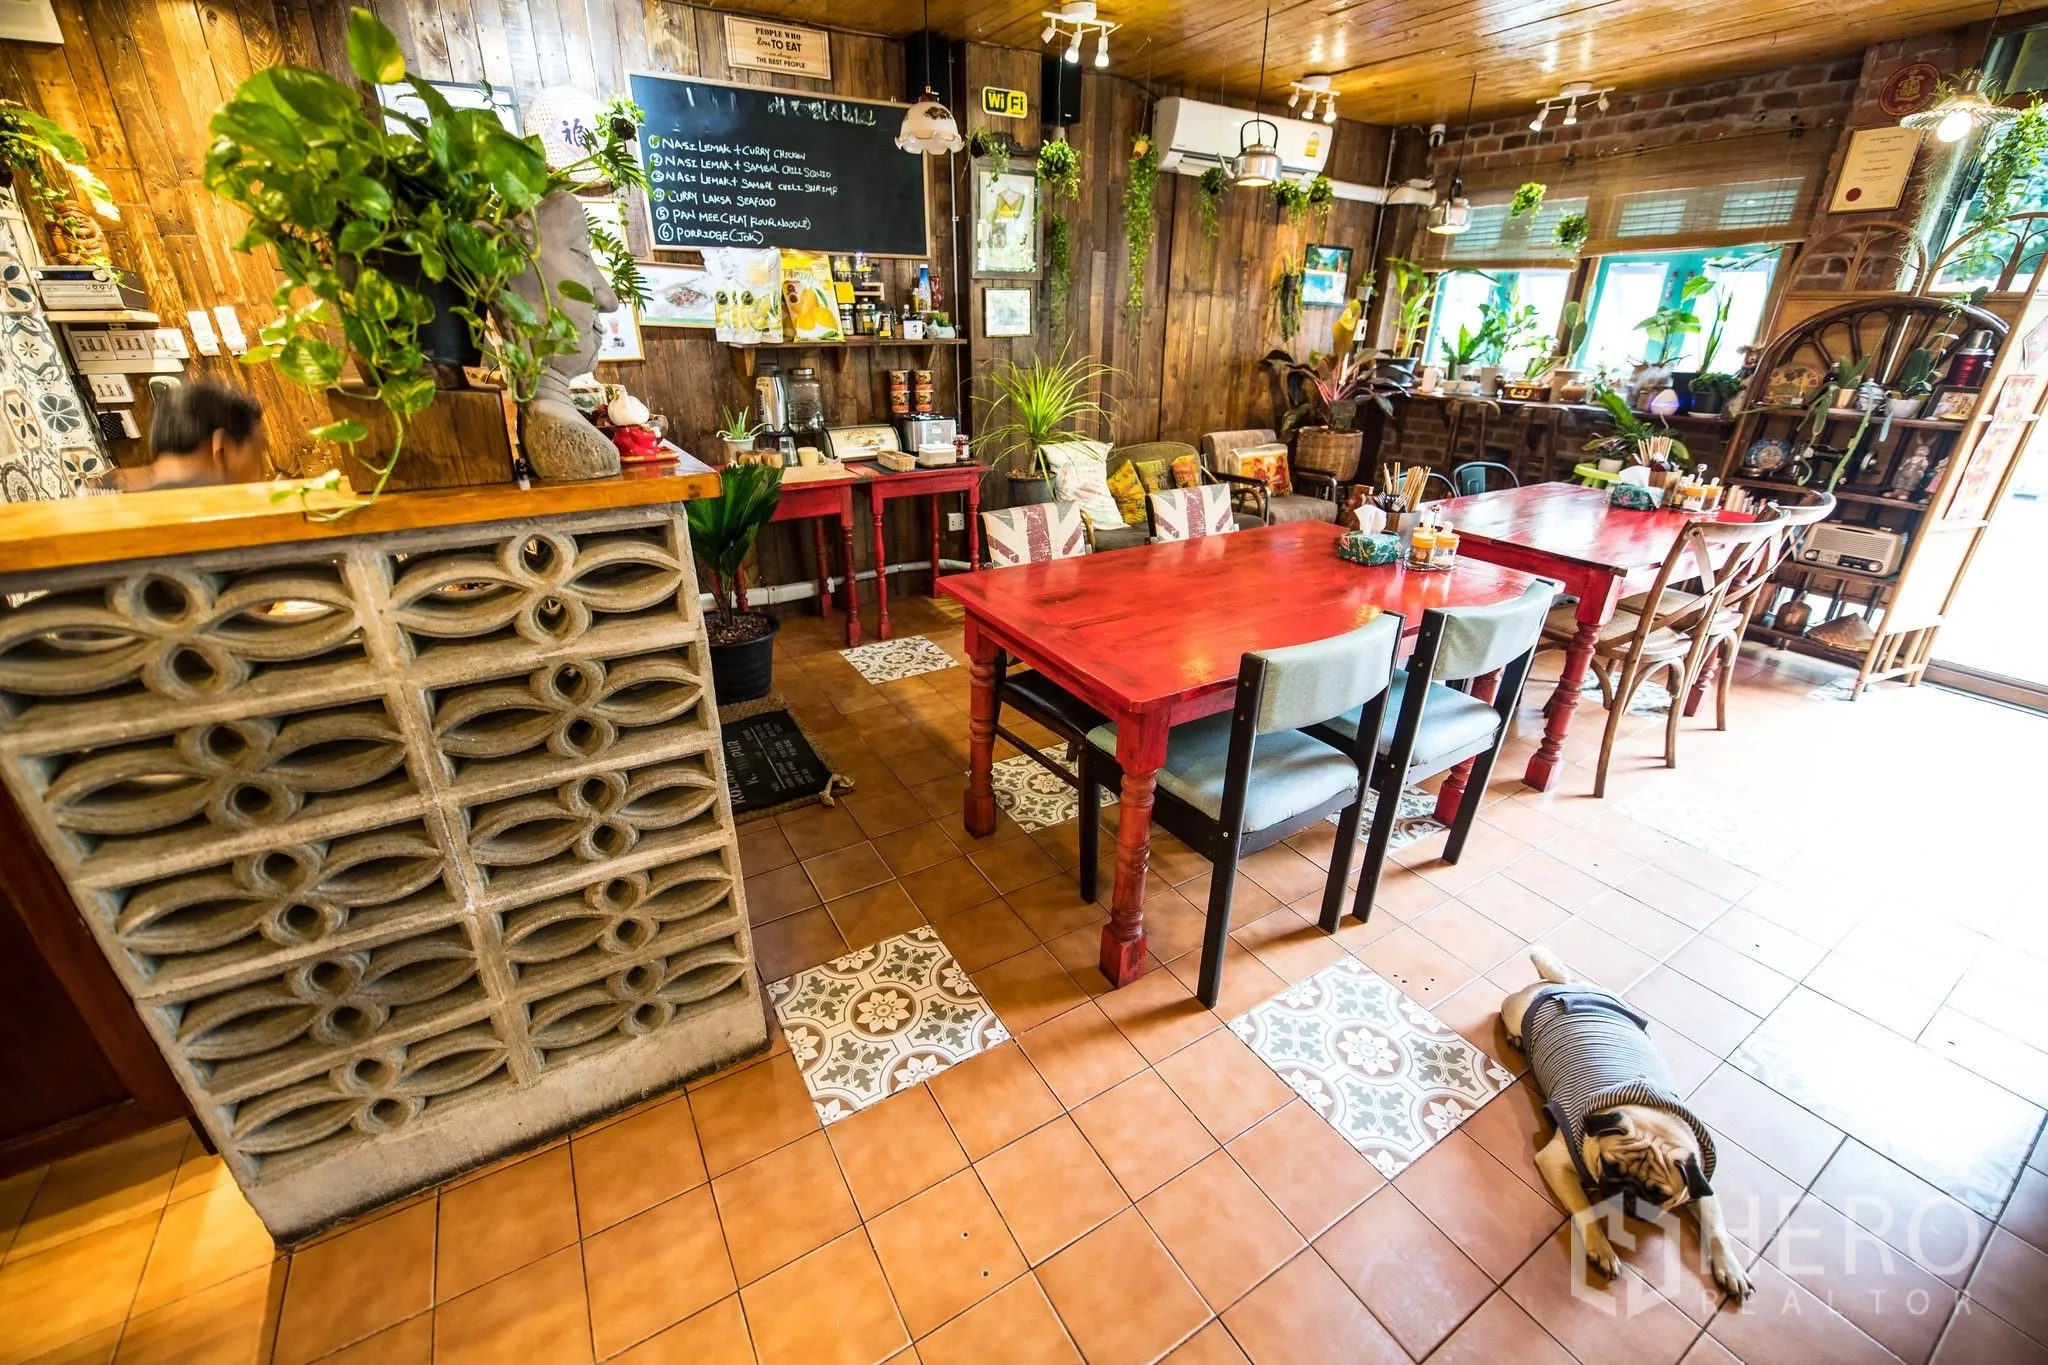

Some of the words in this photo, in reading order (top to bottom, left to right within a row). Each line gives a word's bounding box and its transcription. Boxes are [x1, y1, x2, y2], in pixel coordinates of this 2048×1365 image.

[755, 27, 782, 38] PEOPLE
[784, 32, 801, 40] WHO
[771, 39, 783, 50] TO
[785, 41, 801, 52] EAT
[756, 56, 767, 64] THE
[768, 58, 782, 66] BEST
[784, 60, 805, 69] PEOPLE
[662, 137, 697, 151] NASI
[698, 139, 731, 154] LEMAK
[742, 145, 770, 162] CURRY
[665, 155, 698, 168] NASI
[700, 158, 733, 170] LEMAK
[743, 161, 780, 174] SAMBAL
[665, 171, 697, 183] NASI
[804, 184, 838, 196] SHRIMP
[668, 190, 698, 205] CURRY
[702, 193, 732, 205] LAKSA
[736, 195, 776, 208] SEAFOOD
[672, 209, 696, 224] PAN
